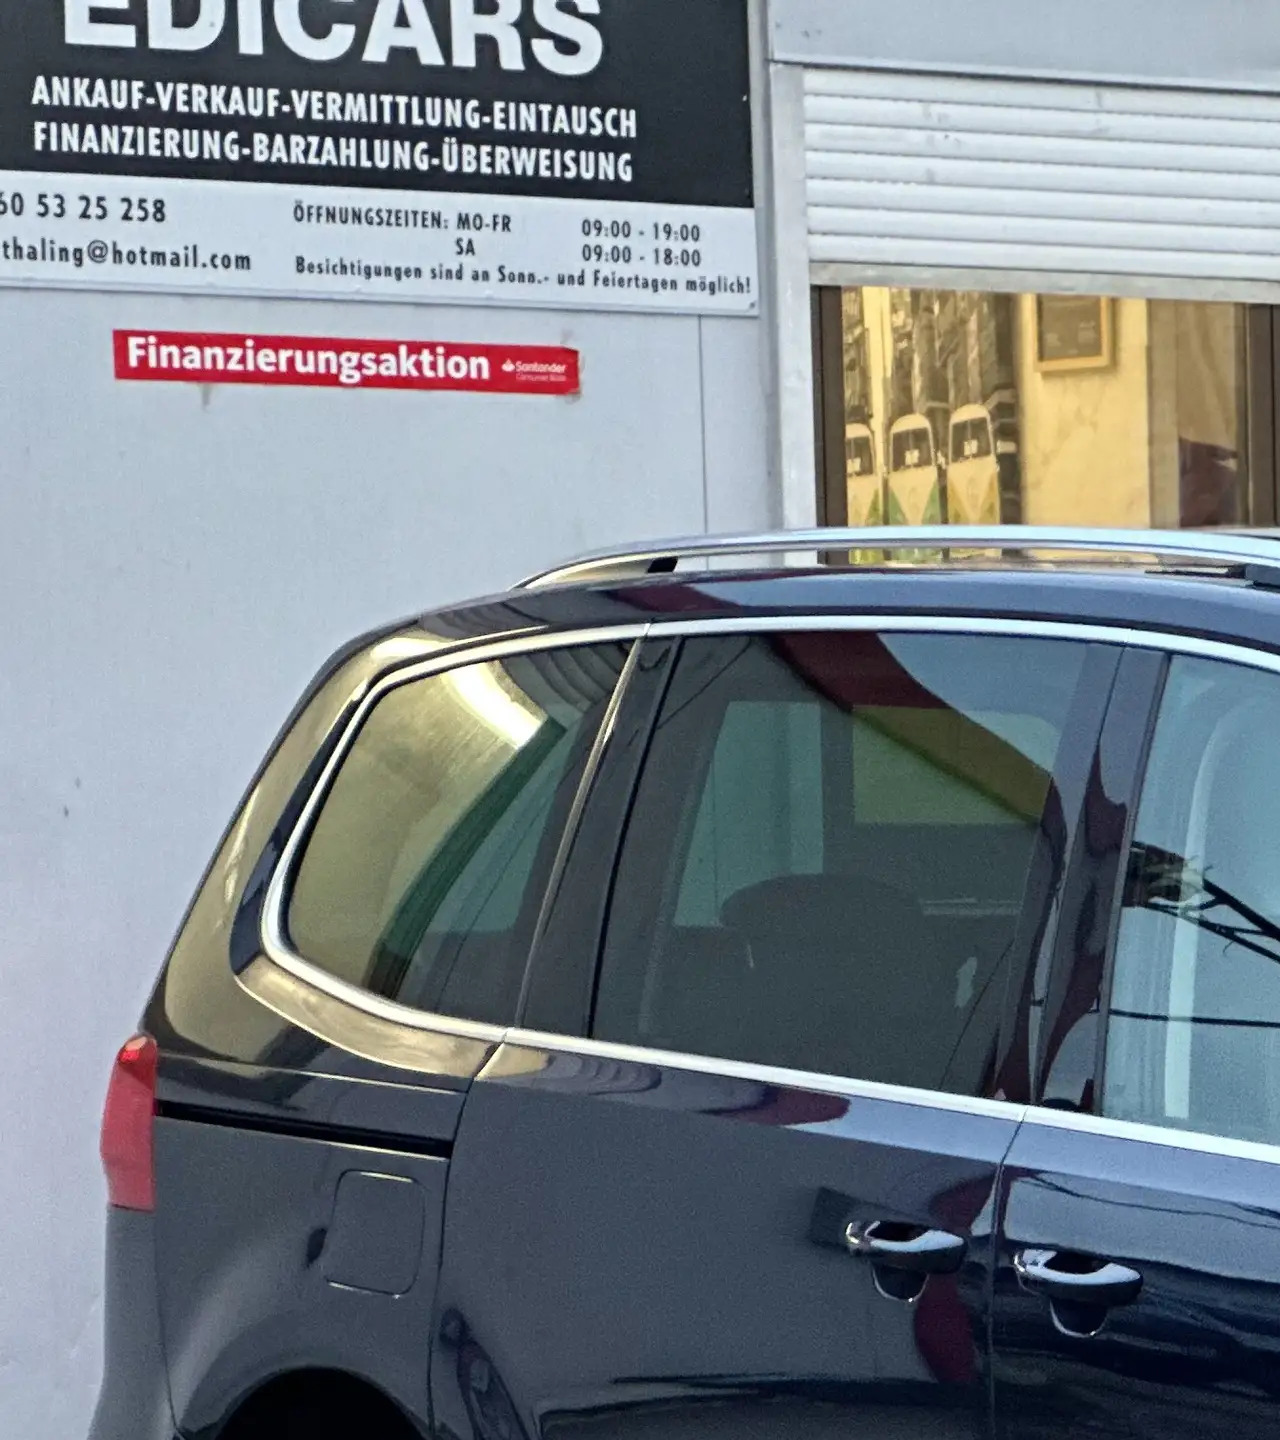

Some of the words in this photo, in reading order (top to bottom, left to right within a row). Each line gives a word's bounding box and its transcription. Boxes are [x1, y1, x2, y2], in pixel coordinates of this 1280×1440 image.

[31, 75, 637, 138] ANKAUF-VERKAUF-VERMITTLUNG-EINTAUSCH
[33, 121, 633, 182] FINANZIERUNG-BARZAHLUNG-ÜBERWEISUNG
[37, 193, 66, 218] 53
[78, 195, 108, 220] 25
[120, 197, 166, 222] 258
[293, 199, 449, 230] ÖFFNUNGSZEITEN:
[456, 212, 512, 233] MO-FR
[581, 219, 631, 239] 09:00
[653, 222, 700, 242] 19:00
[2, 235, 252, 270] thaling@hotmail.com
[455, 238, 476, 257] SA
[581, 244, 632, 263] 09:00
[653, 248, 701, 267] 18:00
[295, 255, 422, 282] Besichtigungen
[430, 262, 464, 281] sind
[471, 268, 490, 282] an
[498, 265, 550, 285] Sonn.-
[557, 268, 585, 286] und
[593, 269, 678, 293] Feiertagen
[686, 276, 751, 296] möglich!
[126, 336, 490, 384] Finanzierungsaktion
